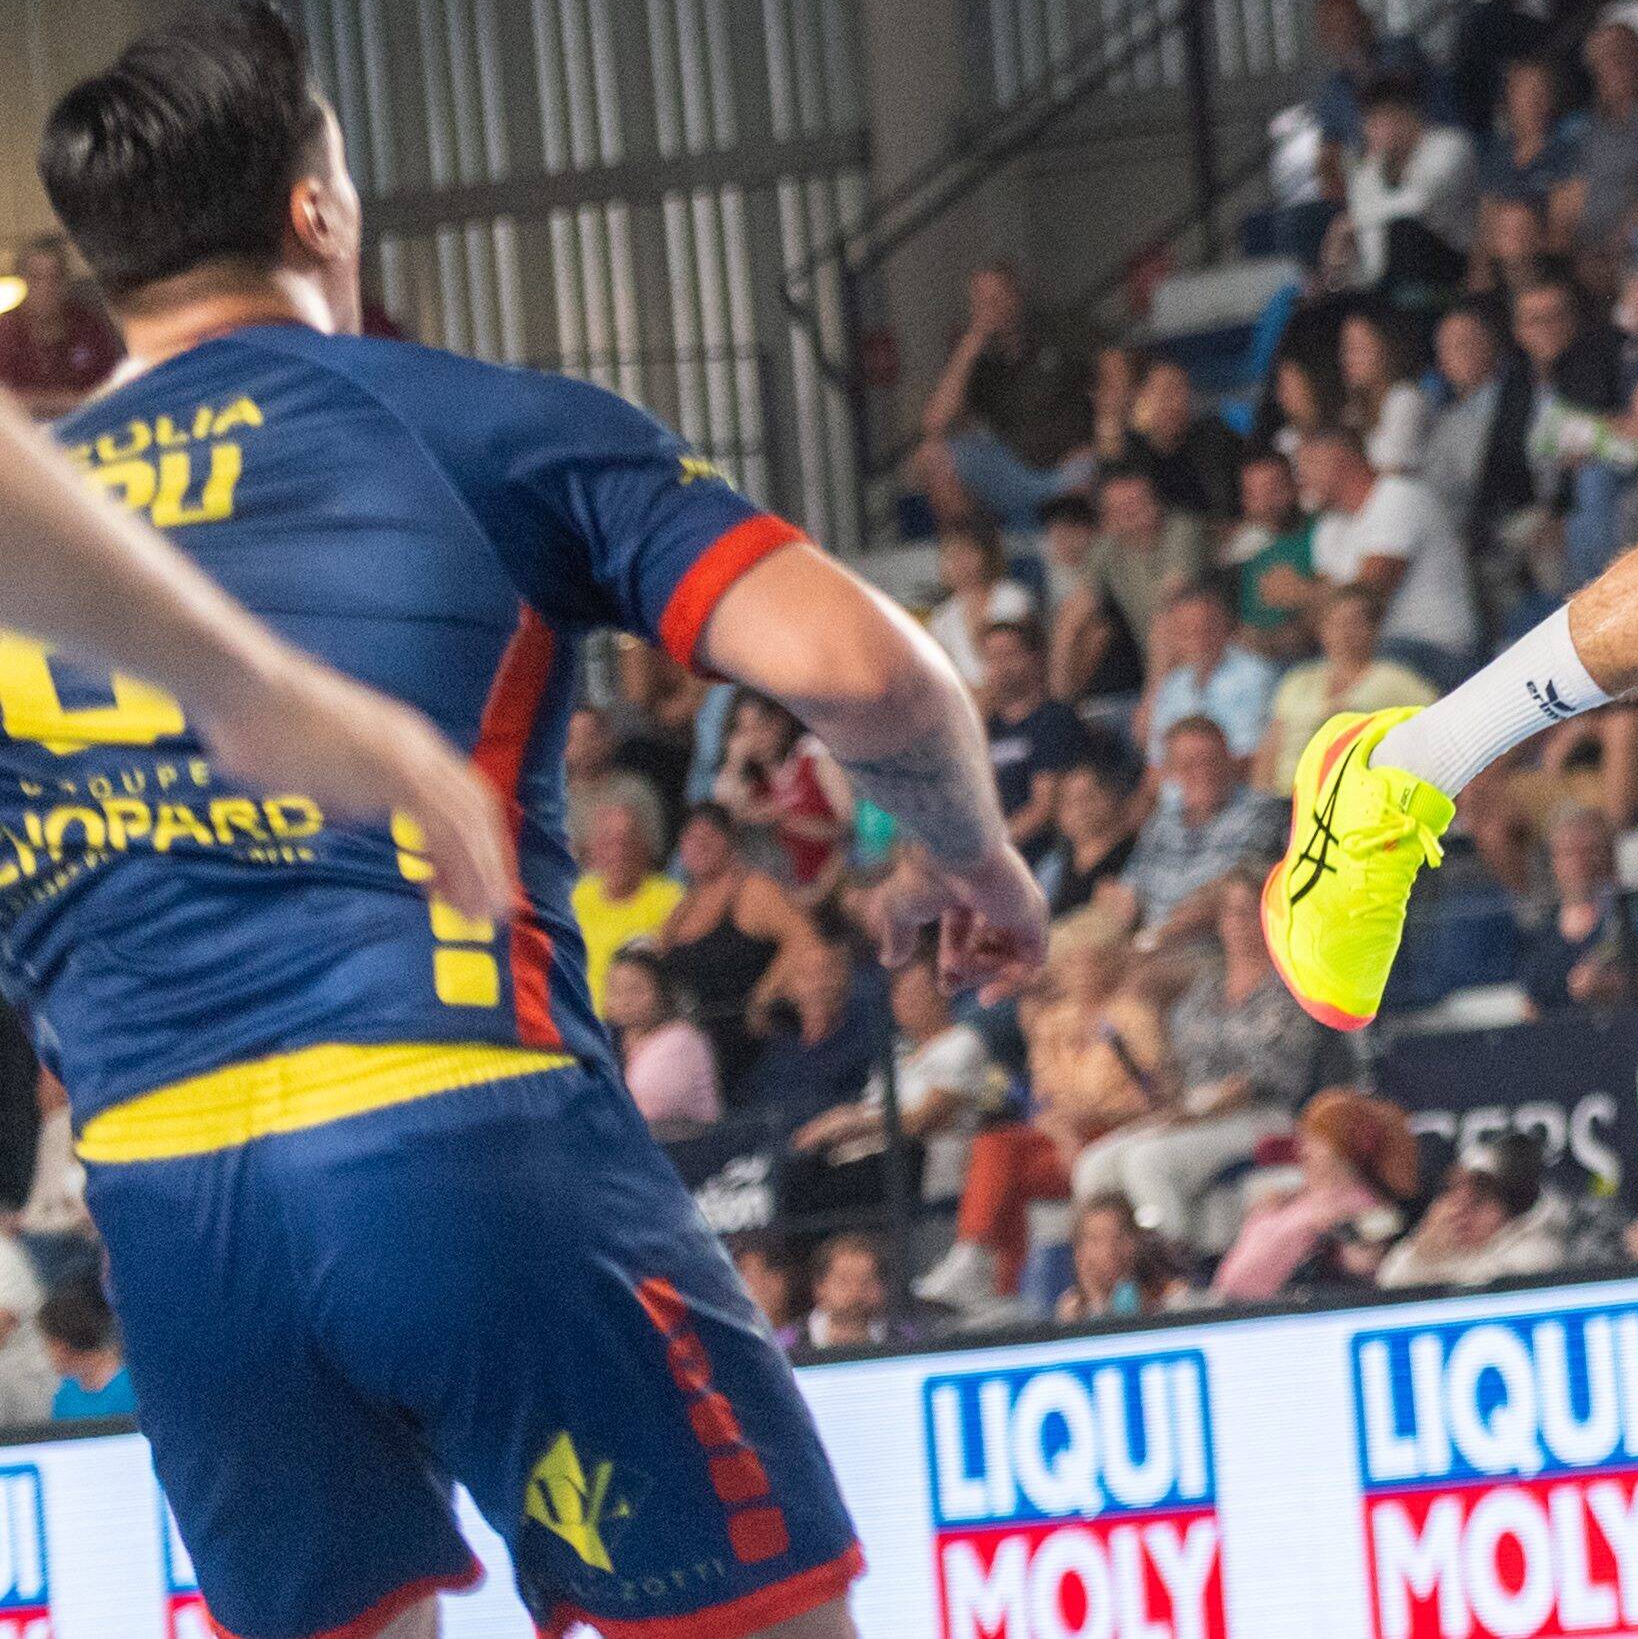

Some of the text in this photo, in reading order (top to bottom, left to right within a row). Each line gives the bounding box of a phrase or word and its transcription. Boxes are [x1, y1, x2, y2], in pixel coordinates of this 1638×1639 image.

[1526, 680, 1563, 721] erim
[934, 1356, 1204, 1519] LIQUI
[940, 1512, 1222, 1639] MOLY
